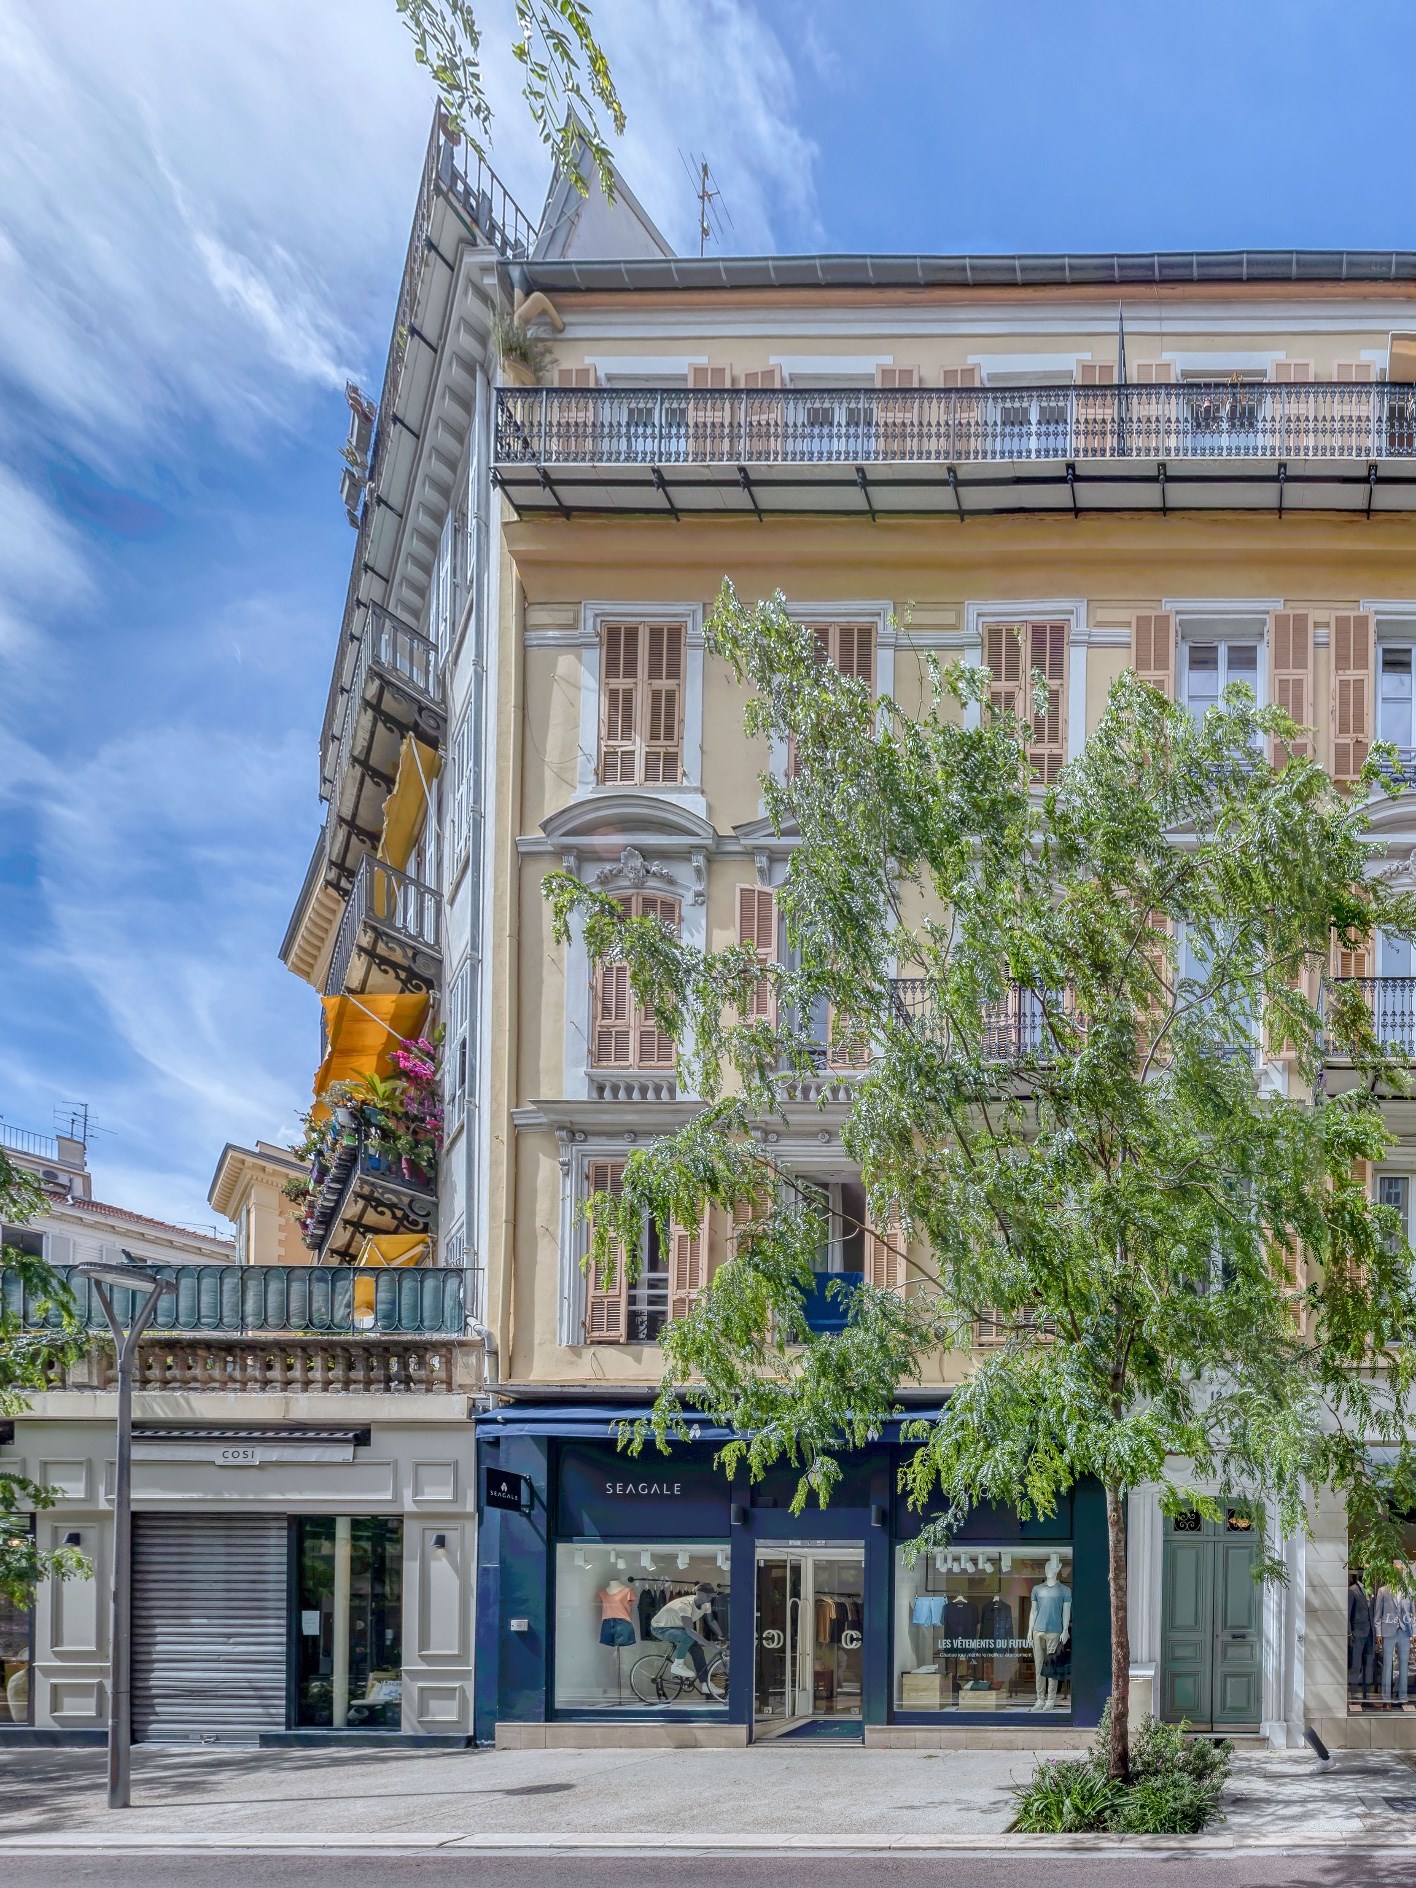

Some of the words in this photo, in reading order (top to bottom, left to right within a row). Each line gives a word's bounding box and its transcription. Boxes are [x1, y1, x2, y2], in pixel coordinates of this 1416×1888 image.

[1211, 1390, 1223, 1401] 12
[222, 1450, 255, 1459] COSI
[606, 1483, 682, 1495] SEAGALE
[489, 1489, 519, 1501] SEAGALE
[1385, 1613, 1399, 1624] Le
[938, 1639, 952, 1649] LES
[996, 1639, 1007, 1649] DU
